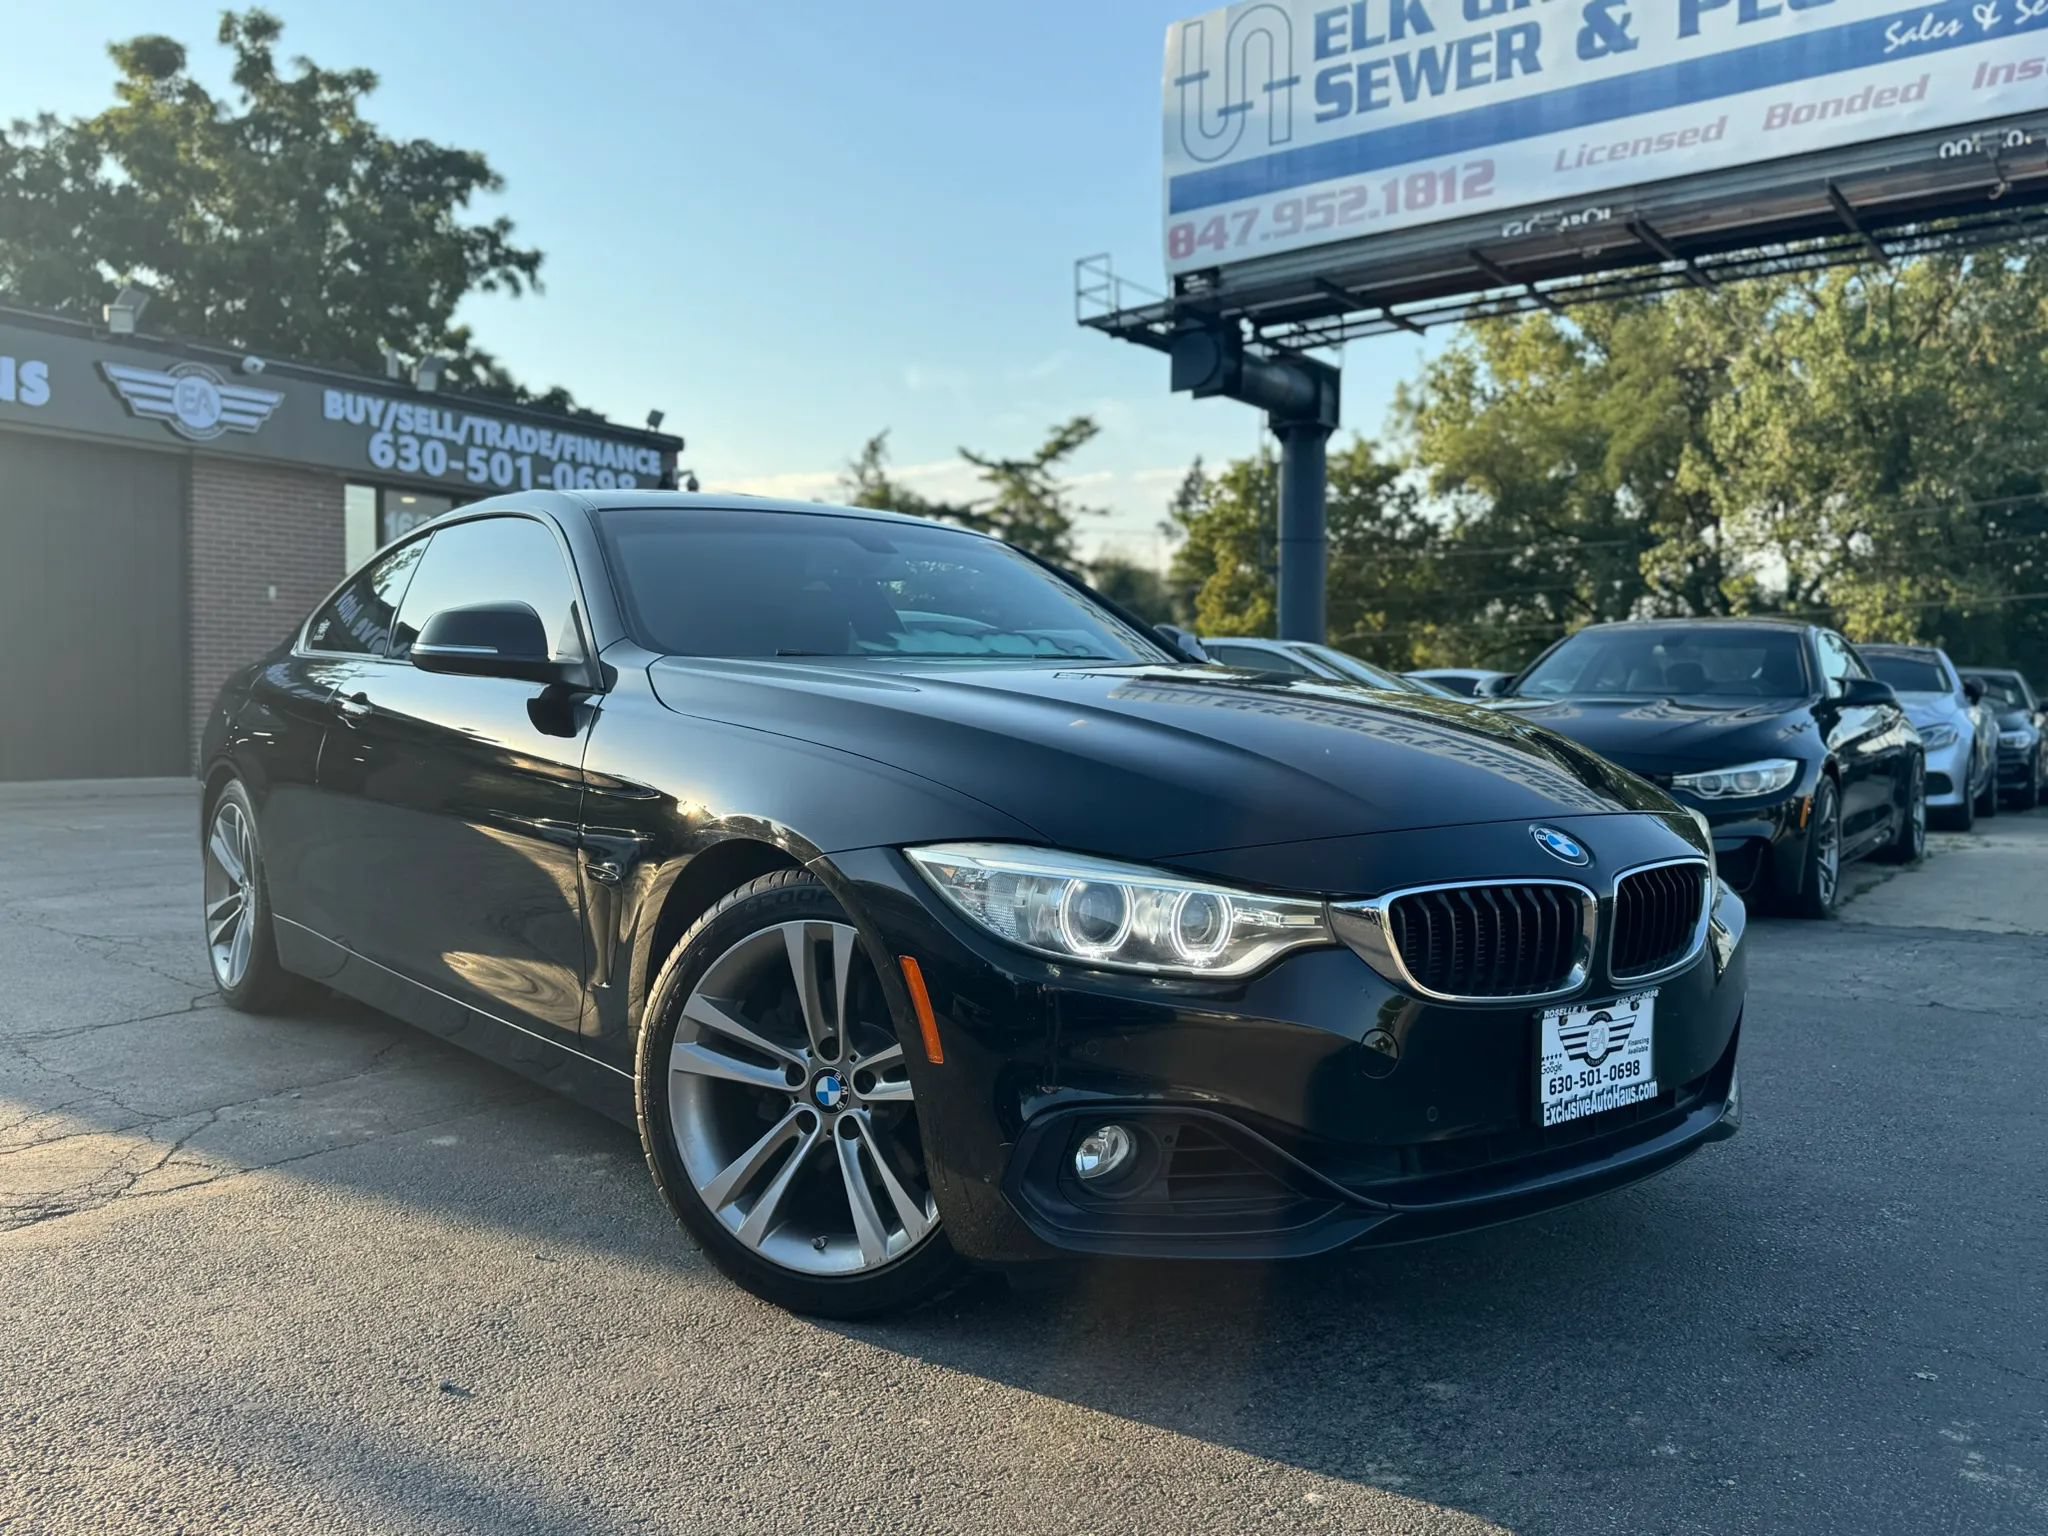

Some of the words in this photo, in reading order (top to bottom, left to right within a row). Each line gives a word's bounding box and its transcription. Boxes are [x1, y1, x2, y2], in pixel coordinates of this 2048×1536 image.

[1314, 0, 1435, 61] ELK
[1883, 12, 1964, 54] Sales
[1972, 0, 2003, 31] &
[1314, 20, 1542, 124] SEWER
[1576, 0, 1639, 61] &
[1168, 159, 1495, 261] 847.952.1812
[1554, 115, 1728, 173] Licensed
[1762, 74, 1930, 131] Bonded
[1972, 56, 2048, 90] Ins
[323, 389, 662, 477] BUY/SELL/TRADE/FINANCE
[1543, 1080, 1658, 1127] ExclusiveAutoHaus.com
[1549, 1059, 1641, 1096] 630-501-0698
